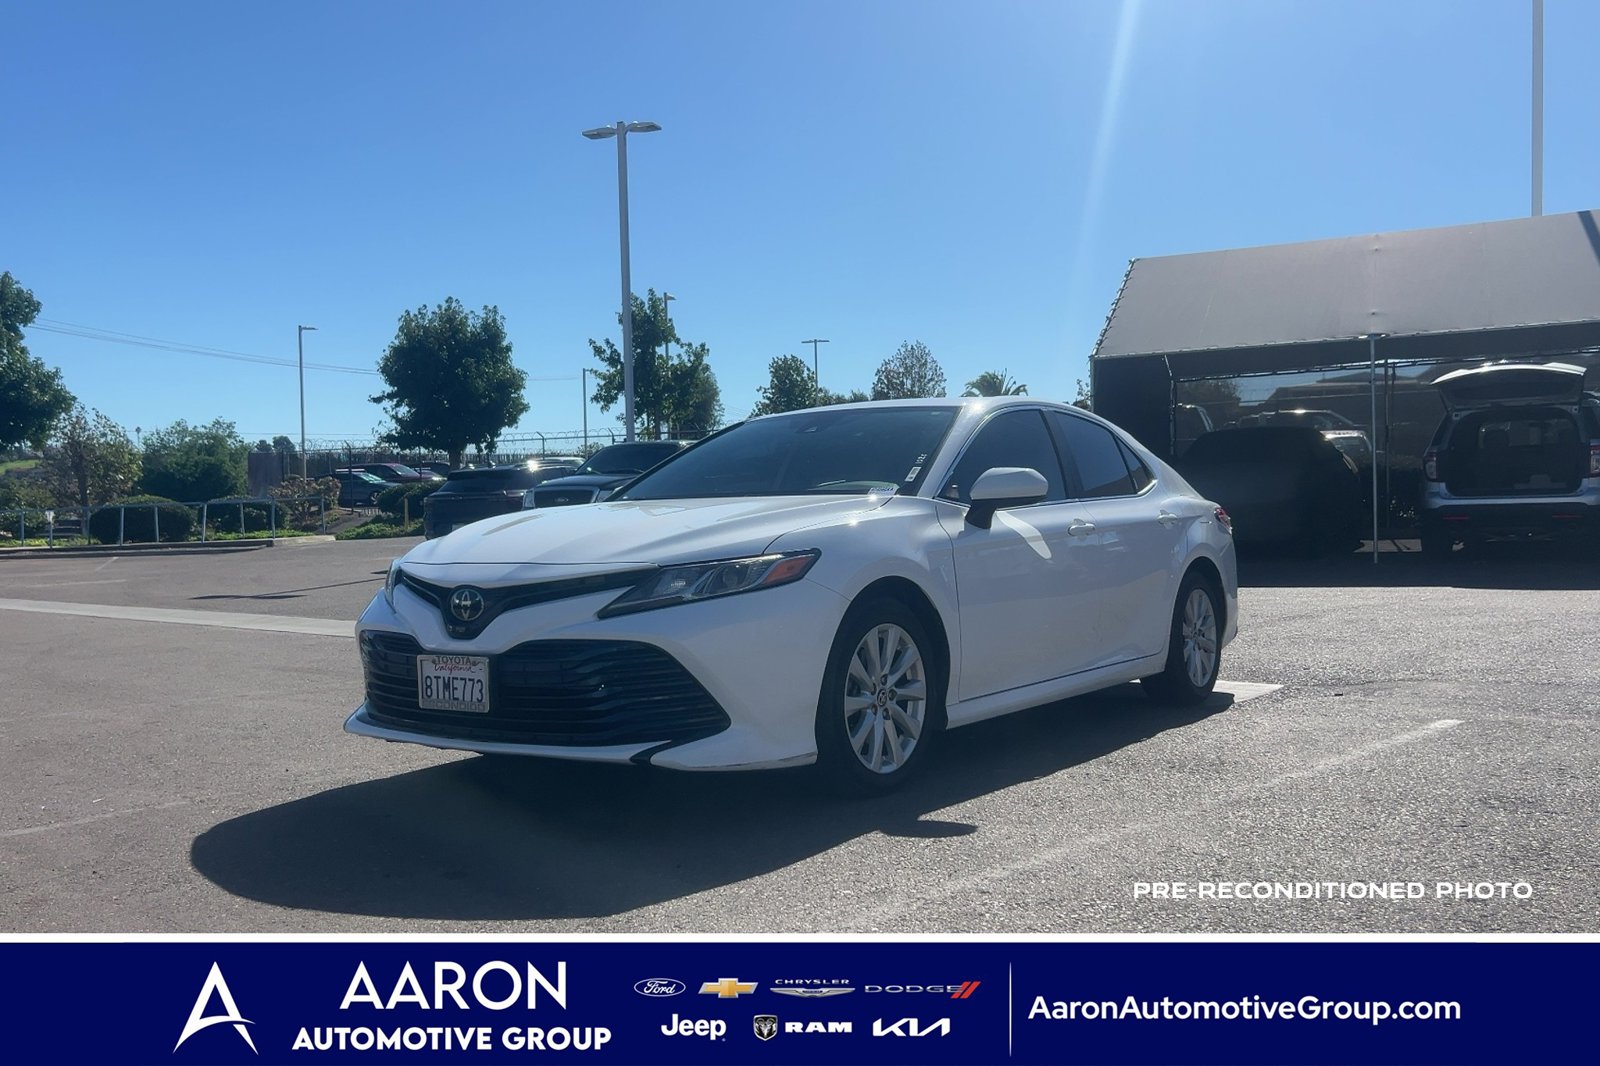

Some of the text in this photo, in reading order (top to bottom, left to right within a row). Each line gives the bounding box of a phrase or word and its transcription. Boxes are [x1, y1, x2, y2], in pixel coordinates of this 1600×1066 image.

[435, 655, 472, 665] TOYOTA
[434, 664, 476, 675] California
[424, 675, 484, 703] 8TME773
